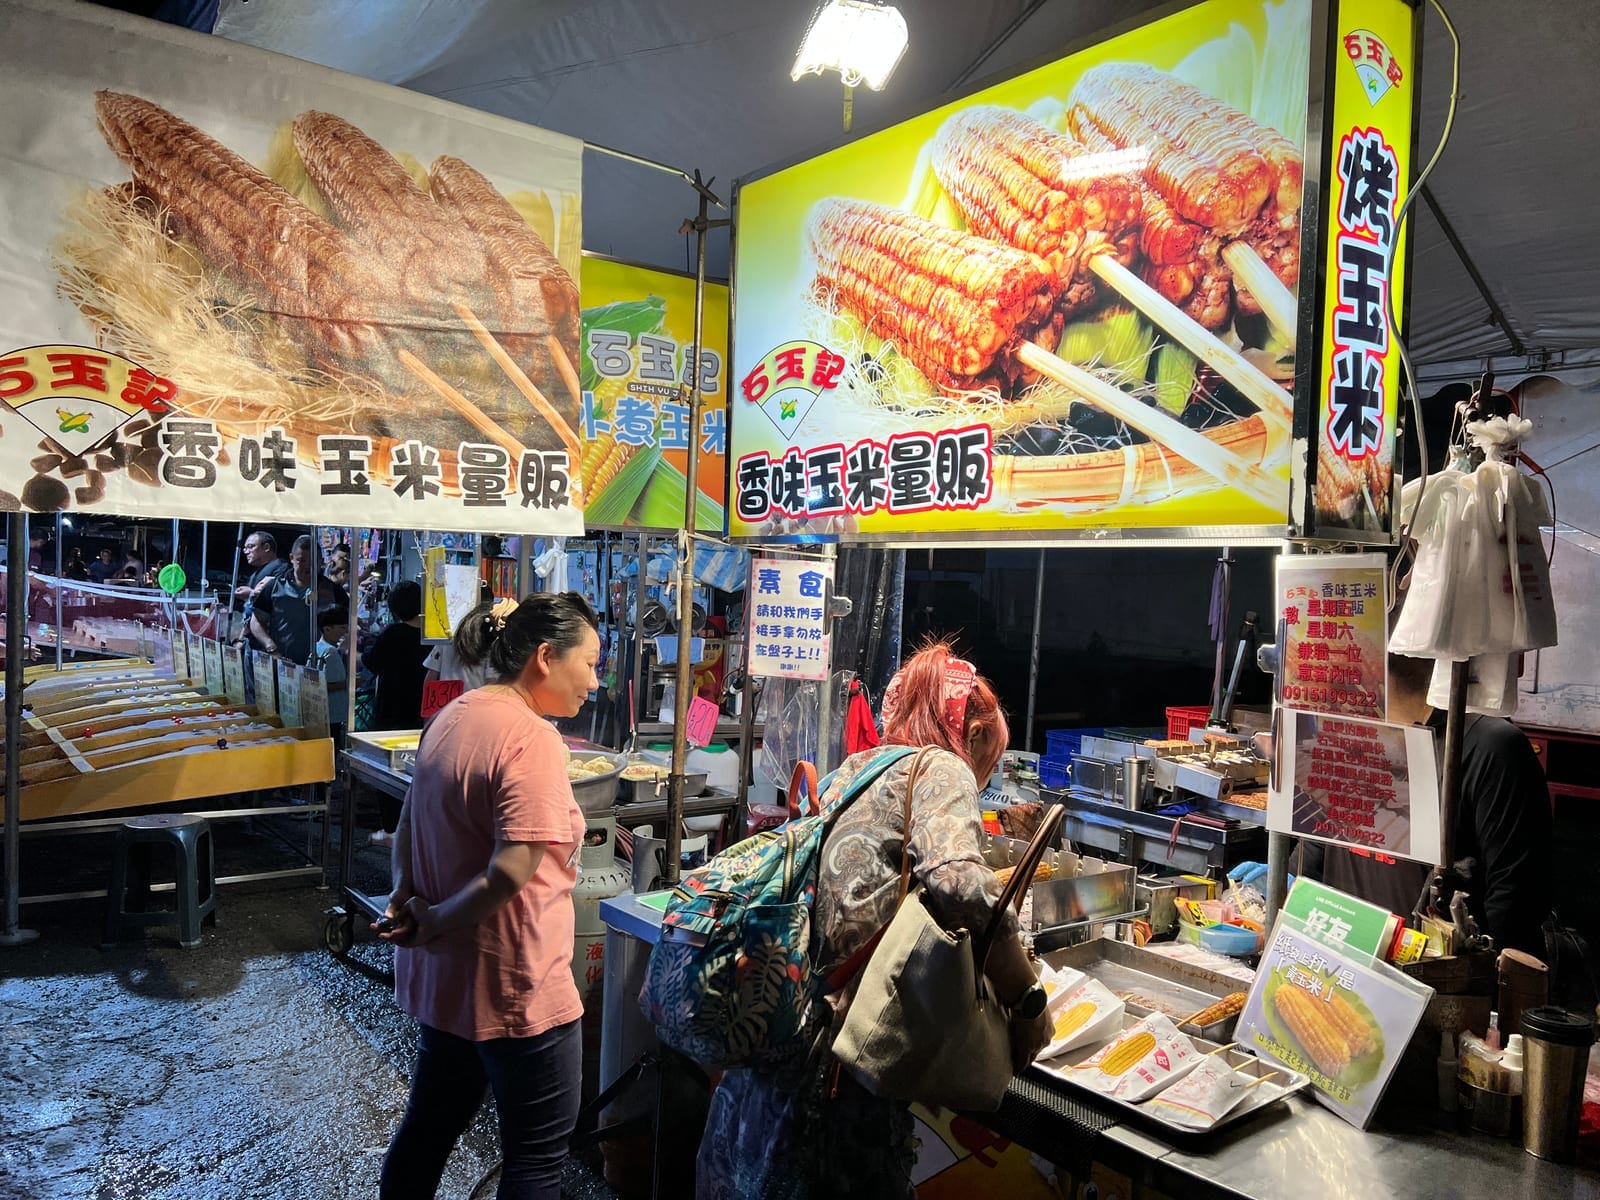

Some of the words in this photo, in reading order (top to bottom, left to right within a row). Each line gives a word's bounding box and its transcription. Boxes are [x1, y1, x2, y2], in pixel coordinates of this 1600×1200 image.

[1332, 135, 1396, 456] 烤玉米
[742, 347, 845, 402] 石玉記
[161, 420, 571, 511] 香味玉米量販
[738, 431, 988, 517] 香味玉米量販
[1321, 582, 1377, 598] 香味玉米
[756, 604, 823, 621] 請和我們手
[1306, 621, 1354, 640] 星期六
[1283, 685, 1377, 707] 0915199322
